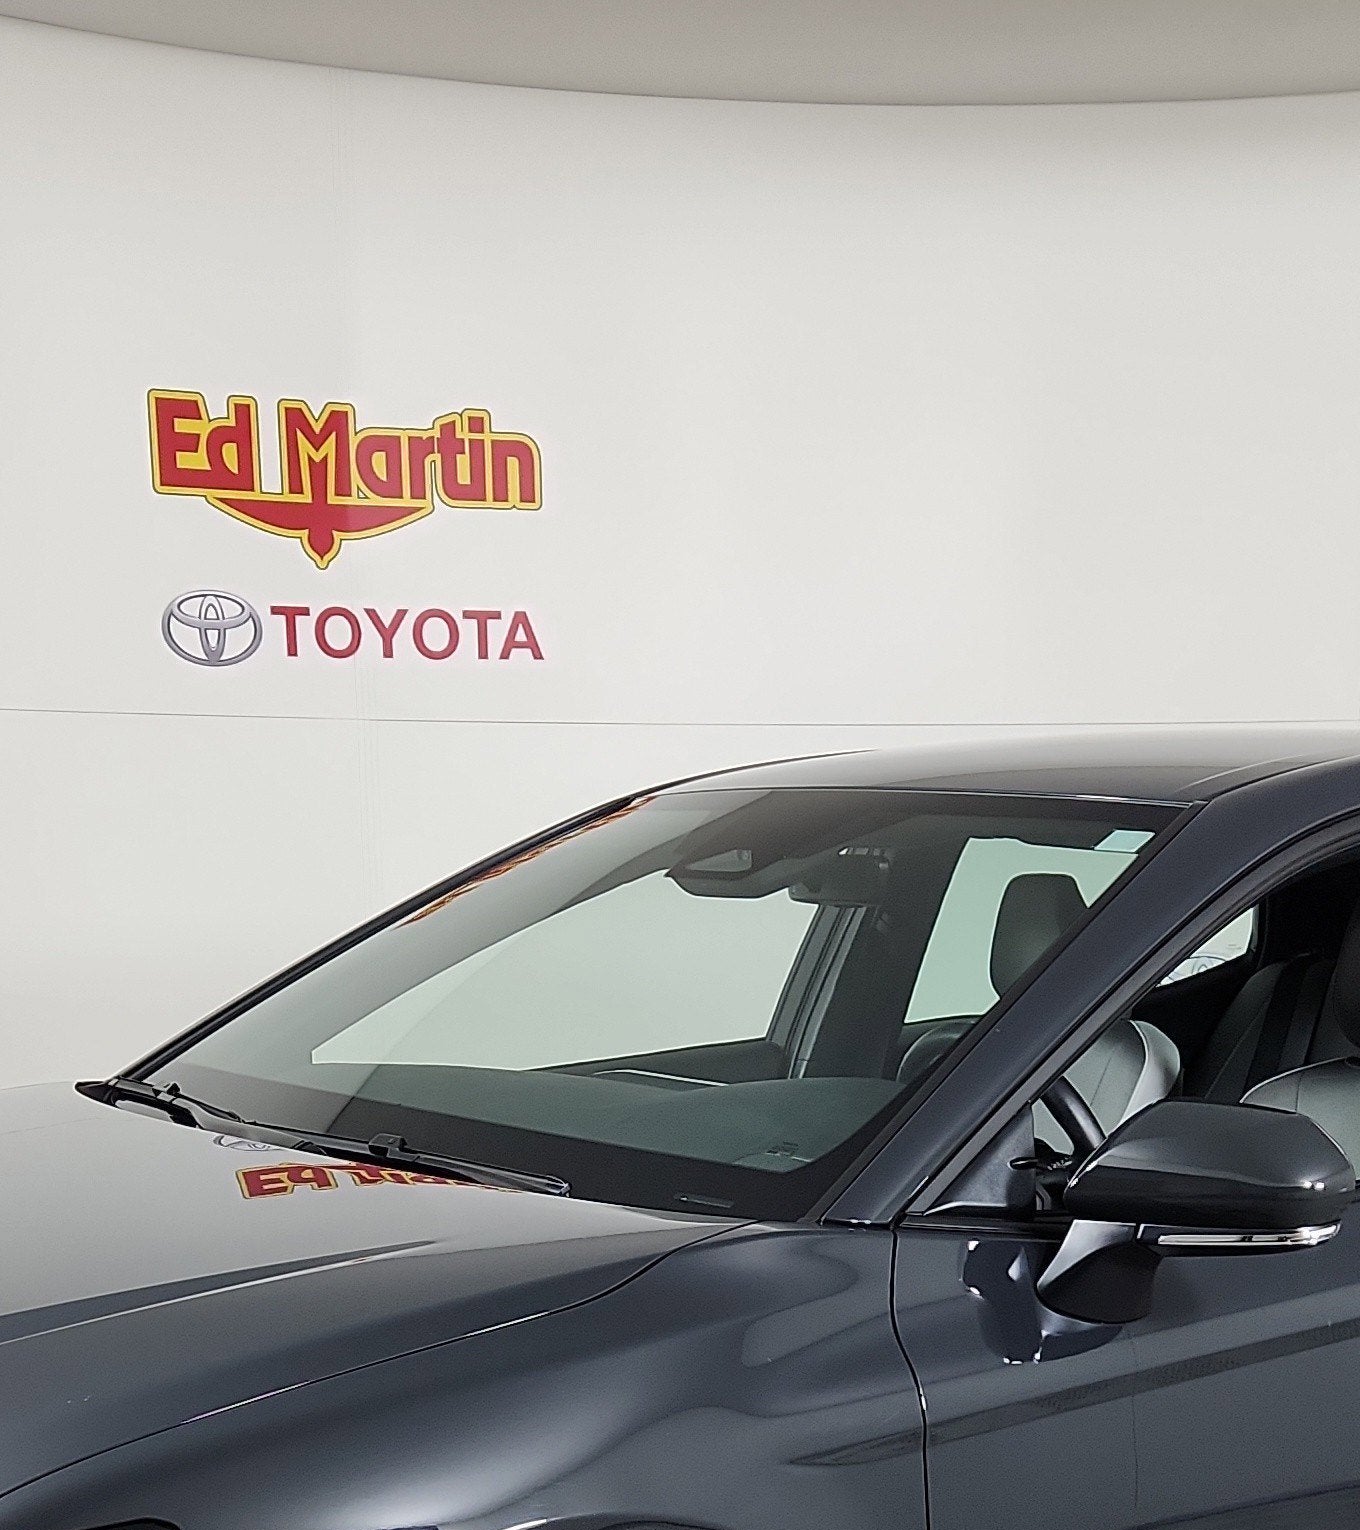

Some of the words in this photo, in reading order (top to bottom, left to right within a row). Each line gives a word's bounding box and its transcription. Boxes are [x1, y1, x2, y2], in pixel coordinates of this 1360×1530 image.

[148, 389, 259, 496] Ed
[277, 398, 542, 512] Martin
[270, 605, 545, 661] TOYOTA
